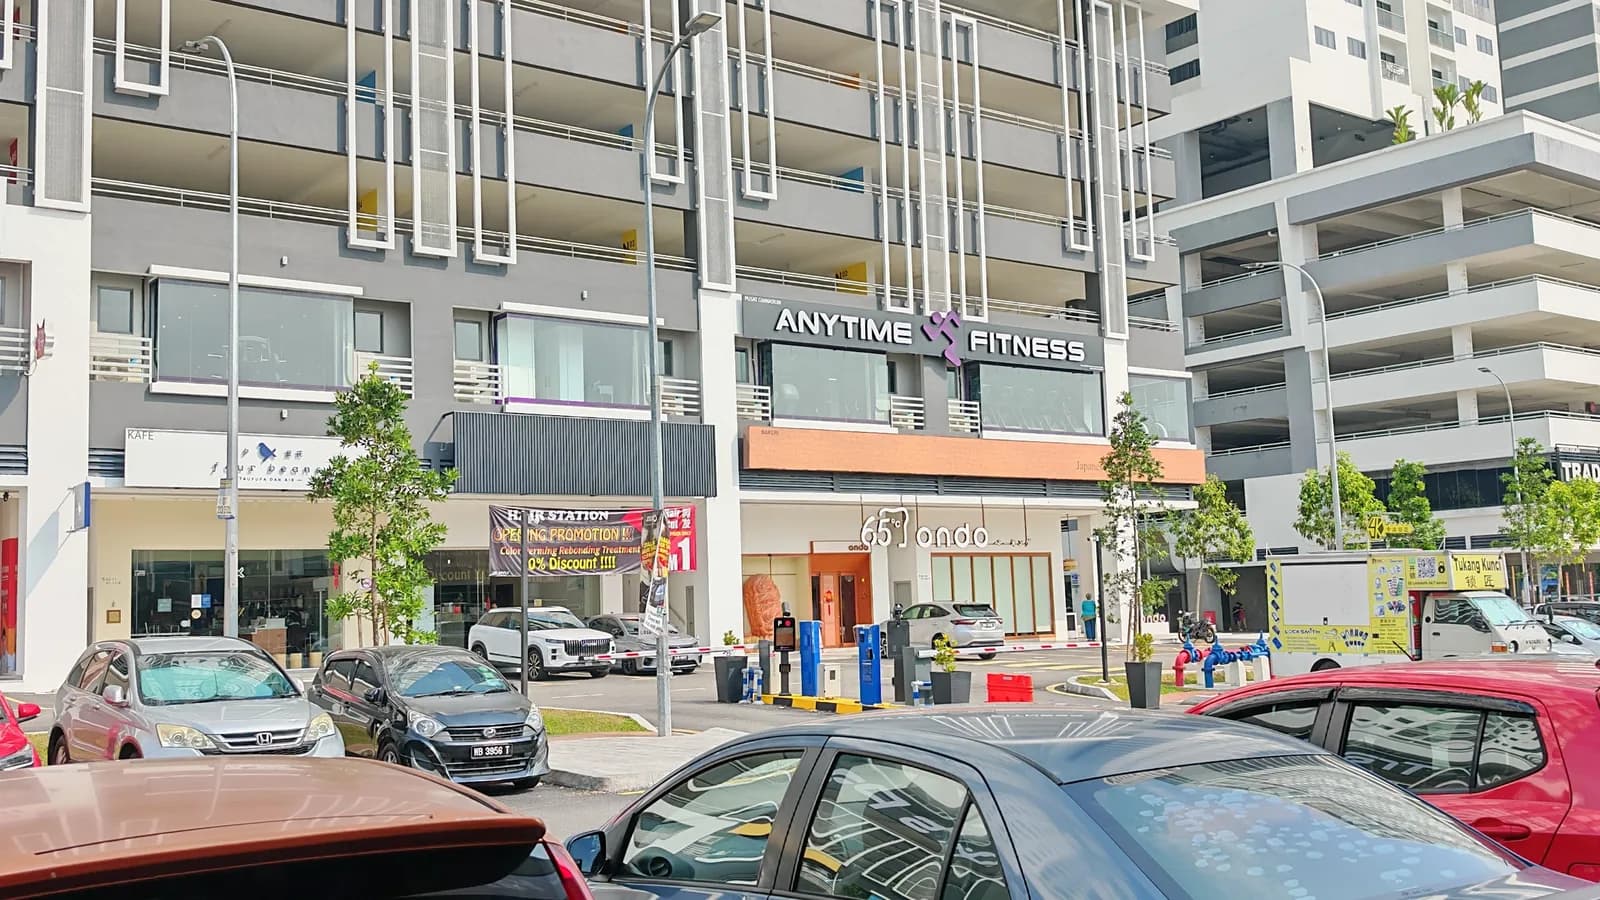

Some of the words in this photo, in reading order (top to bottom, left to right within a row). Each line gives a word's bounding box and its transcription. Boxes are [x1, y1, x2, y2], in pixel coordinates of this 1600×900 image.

[775, 308, 913, 345] ANYTIME
[970, 329, 1085, 362] FITNESS
[127, 429, 154, 441] KAFE
[547, 510, 609, 521] STATION
[549, 527, 620, 542] PROMOTION
[916, 523, 989, 549] ondo
[527, 547, 558, 557] erming
[559, 546, 600, 556] Rebonding
[602, 546, 640, 555] Treatment
[848, 544, 869, 552] ondo
[549, 556, 598, 570] Discount
[1454, 557, 1480, 573] Tukang
[505, 745, 511, 754] T
